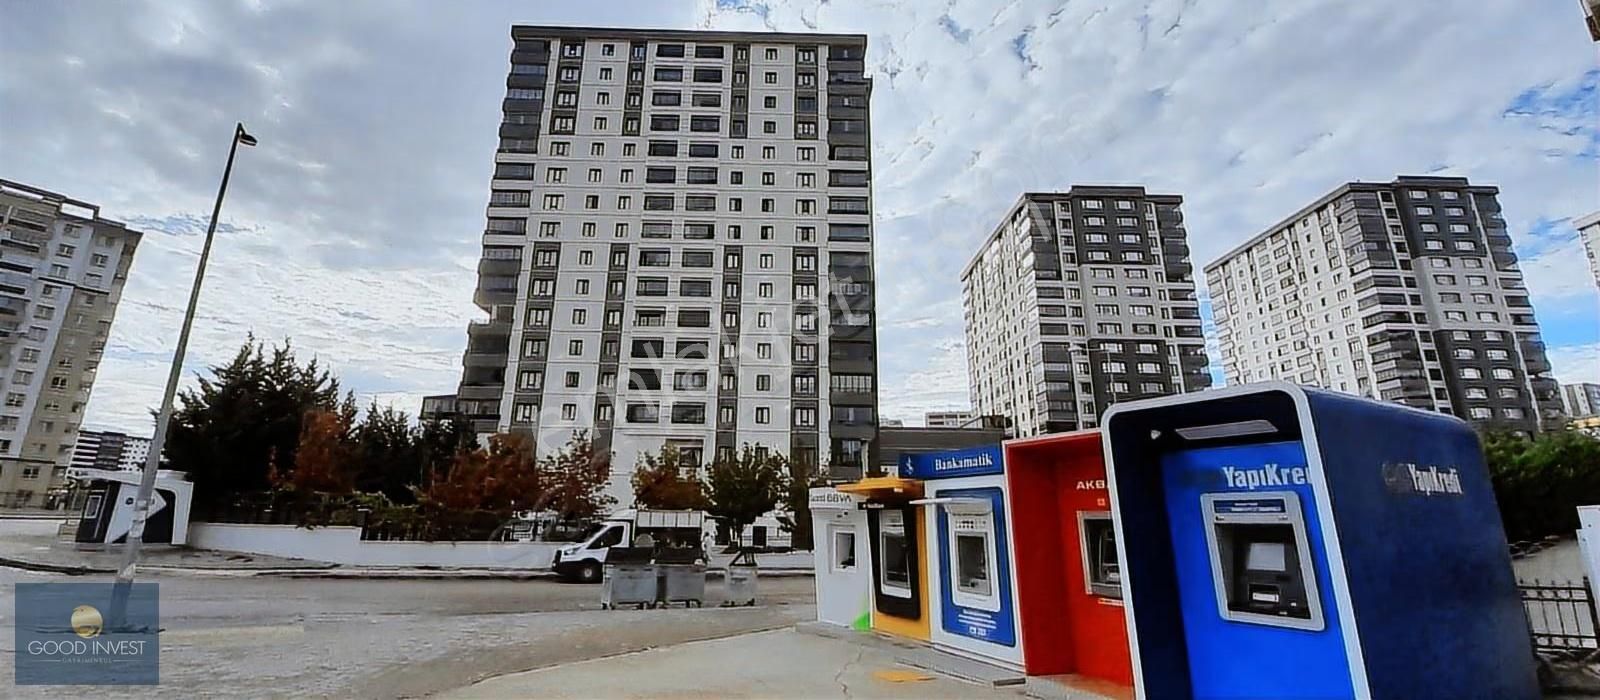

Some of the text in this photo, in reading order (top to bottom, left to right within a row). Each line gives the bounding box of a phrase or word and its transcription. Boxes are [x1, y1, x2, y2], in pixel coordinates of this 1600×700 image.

[935, 453, 993, 471] Bankamatik
[1076, 479, 1108, 490] AKB
[827, 493, 852, 503] BBVA
